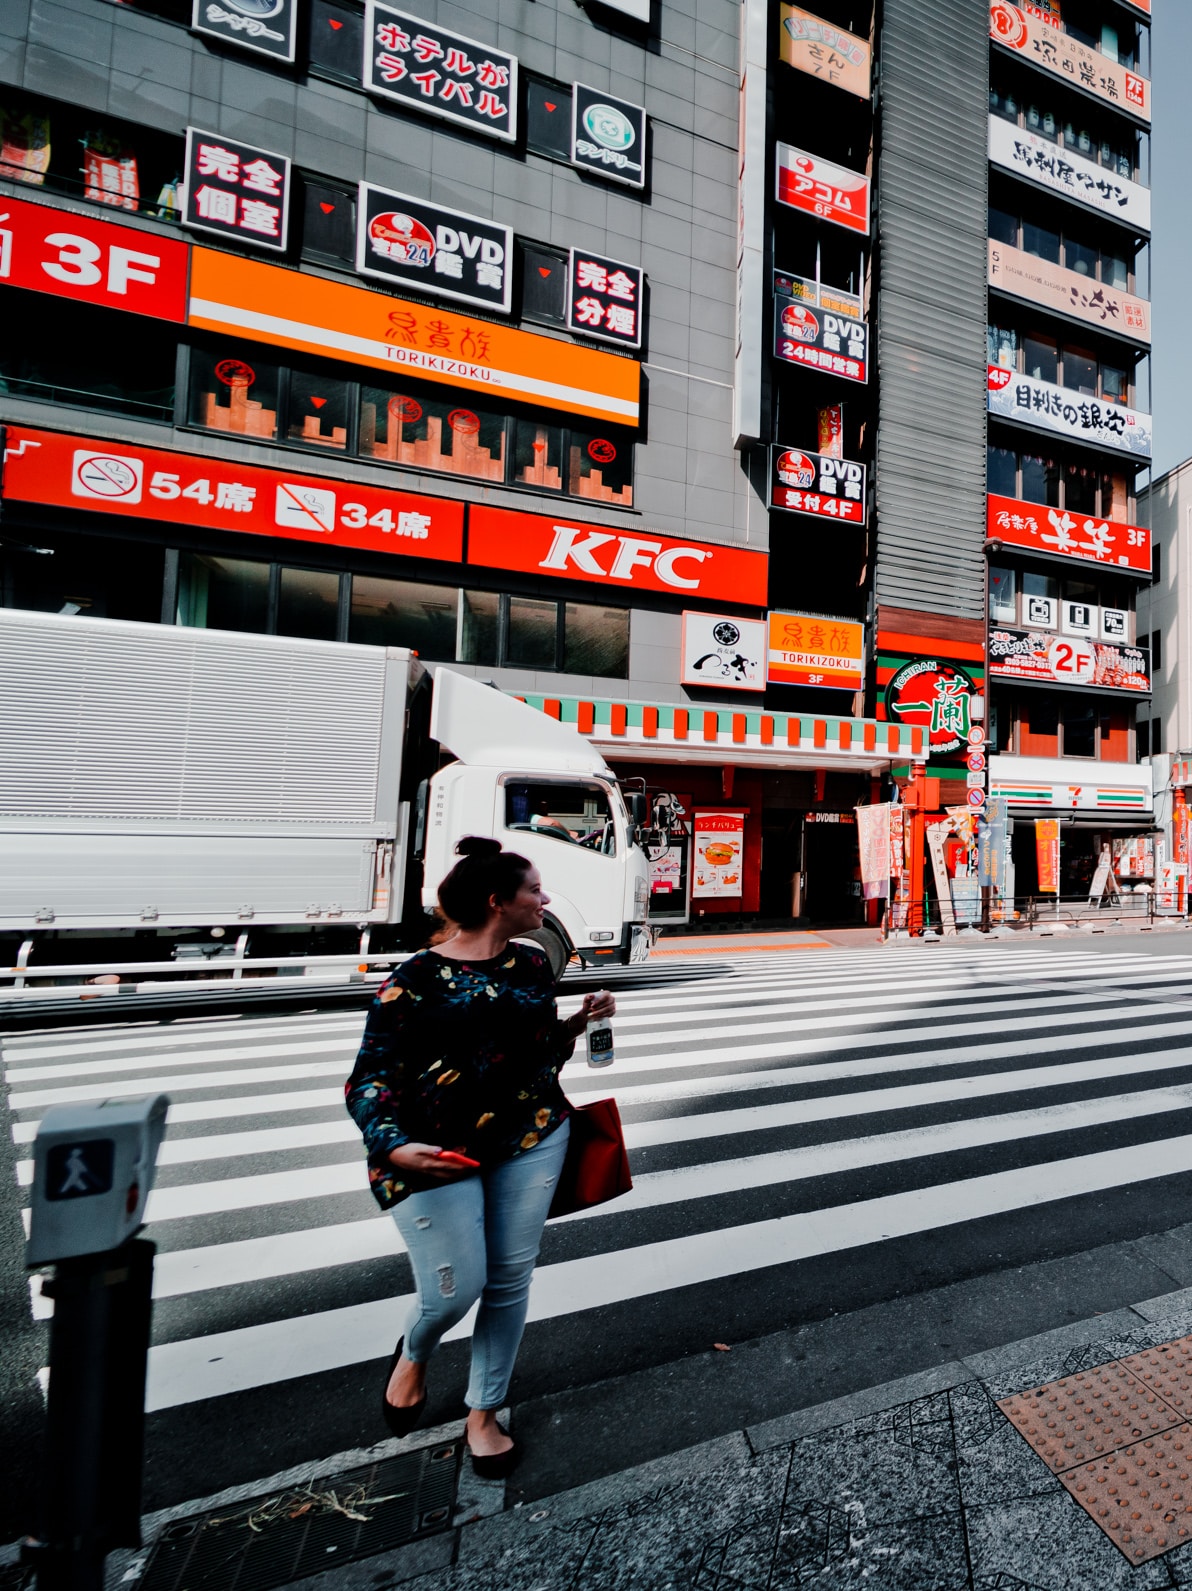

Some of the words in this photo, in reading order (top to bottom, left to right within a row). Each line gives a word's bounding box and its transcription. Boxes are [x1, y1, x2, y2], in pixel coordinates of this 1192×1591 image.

[376, 23, 508, 88] ホテルが
[376, 53, 507, 119] ライバル
[1127, 76, 1142, 93] 7F
[198, 144, 282, 196] 完全
[576, 140, 642, 172] ランドリー
[795, 175, 852, 210] アコム
[814, 202, 833, 217] 6F
[195, 185, 280, 237] 個室
[436, 225, 504, 264] DVD
[41, 232, 160, 295] 3F
[435, 250, 504, 290] 鑑賞
[576, 261, 637, 302] 完全
[576, 296, 636, 337] 分煙
[824, 314, 865, 342] DVD
[384, 311, 492, 362] 鳥貴族
[384, 345, 491, 381] TORIKIZOKU
[782, 341, 860, 377] 24時間営業
[988, 369, 1010, 385] 4F
[1016, 385, 1126, 435] 目利きの銀次
[820, 457, 862, 483] DVD
[149, 472, 256, 513] 54席
[785, 490, 853, 518] 受付4F
[340, 502, 431, 540] 34席
[1127, 529, 1146, 547] 3F
[538, 525, 707, 589] KFC
[781, 623, 851, 653] 鳥貴族
[693, 654, 758, 681] つるぎ
[781, 652, 852, 669] TORIKIZOKU
[894, 661, 938, 690] ICHIRAN
[1056, 643, 1091, 673] 2F
[808, 674, 824, 684] 3F
[892, 675, 971, 740] 一蘭
